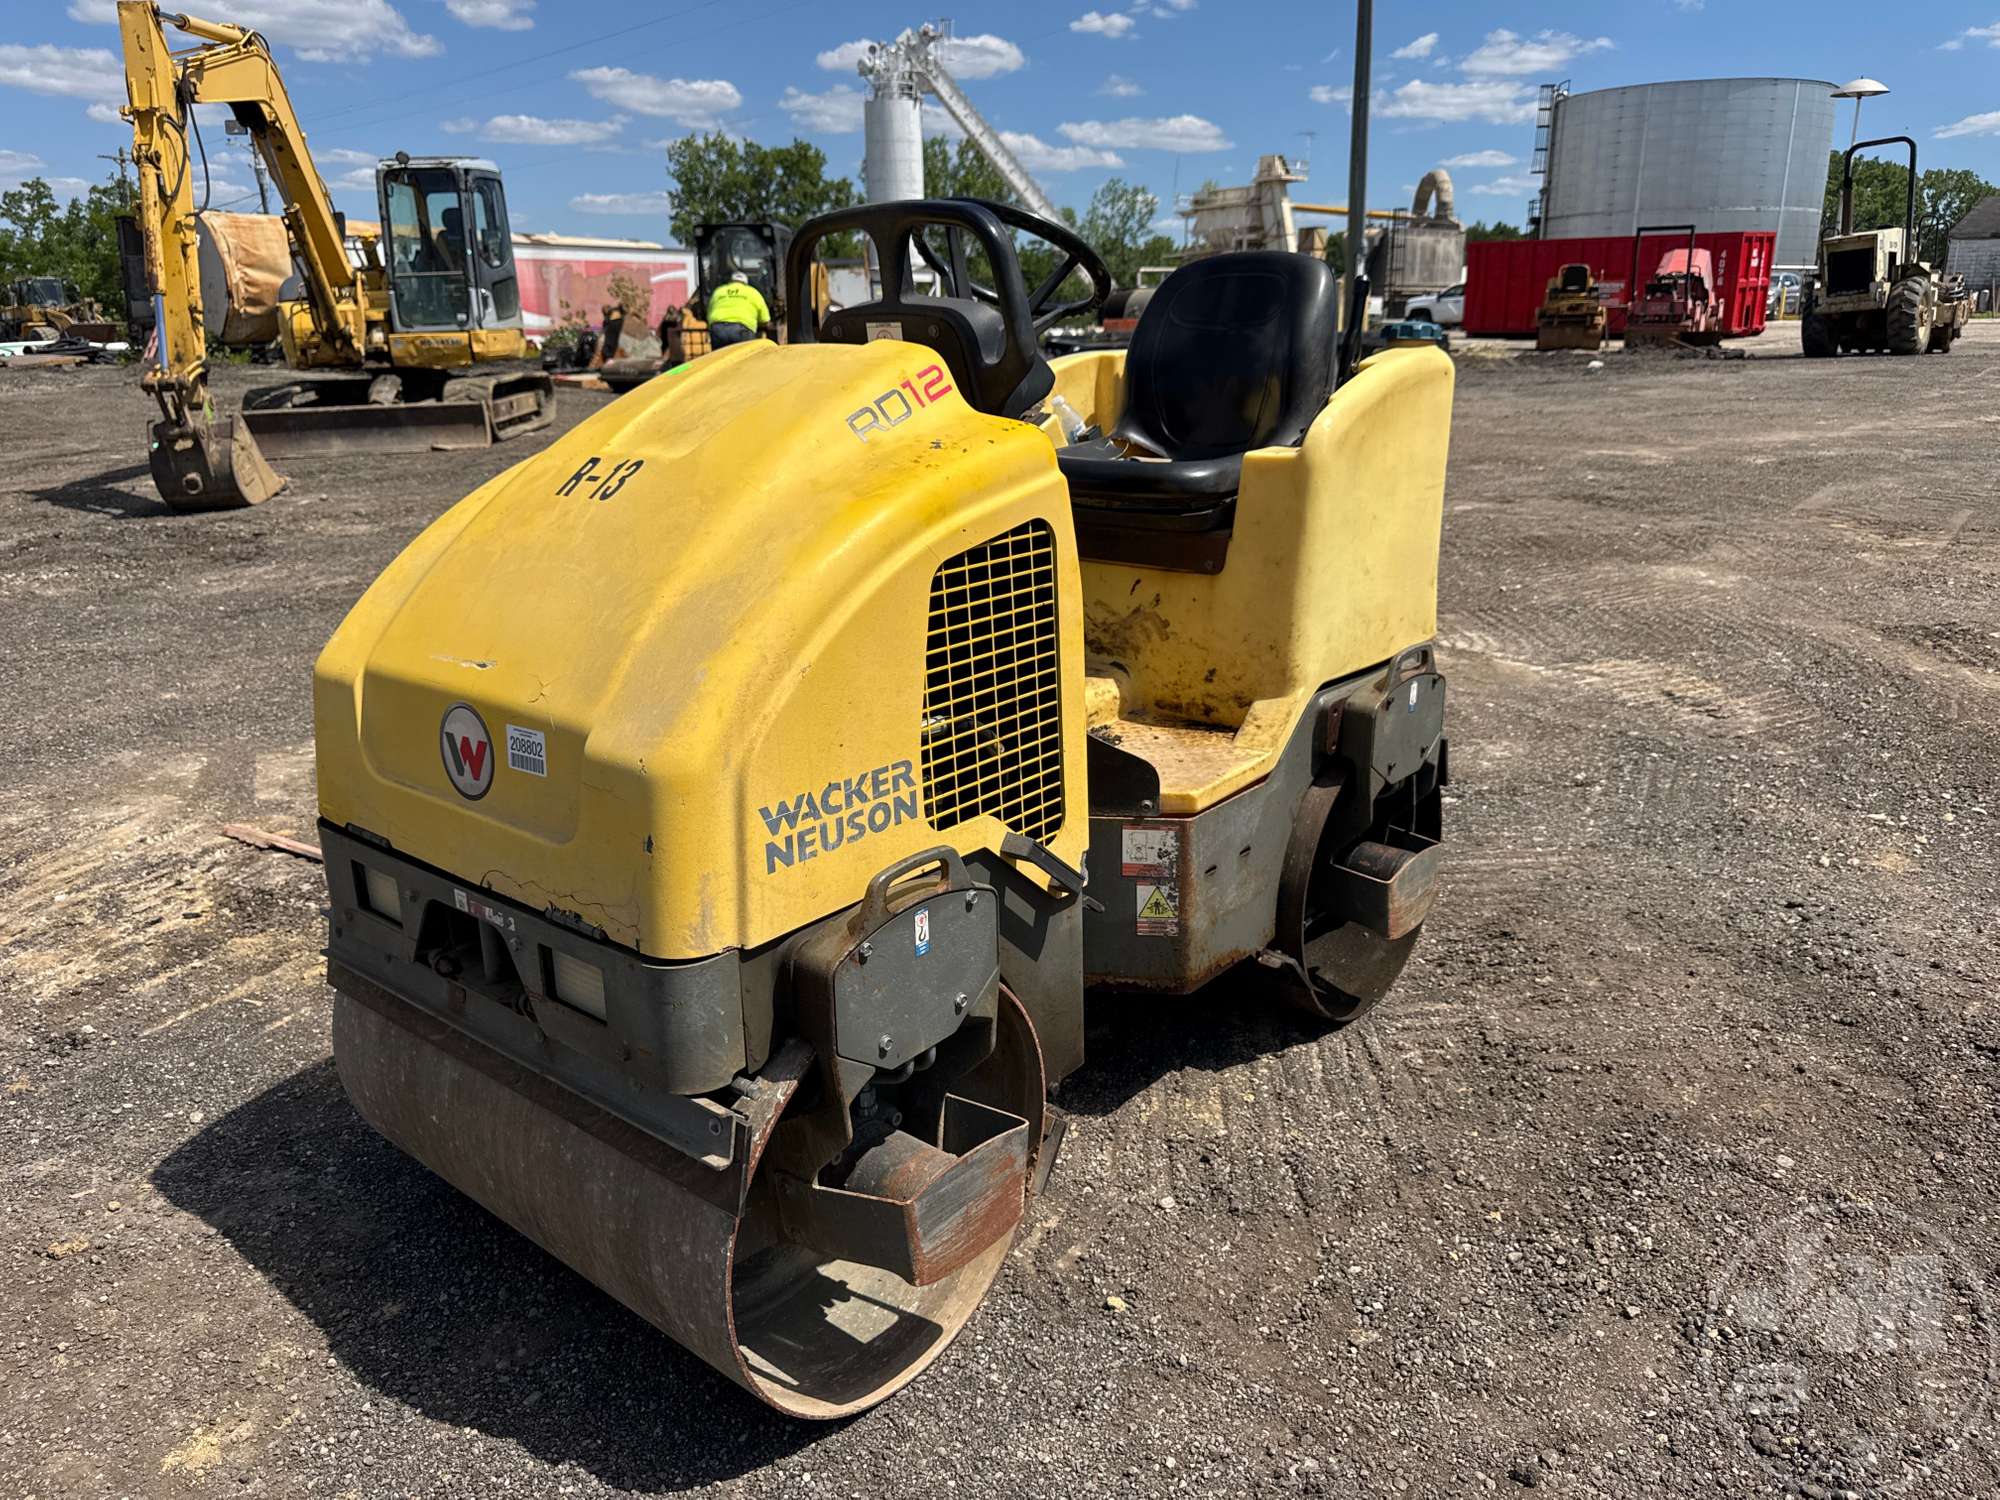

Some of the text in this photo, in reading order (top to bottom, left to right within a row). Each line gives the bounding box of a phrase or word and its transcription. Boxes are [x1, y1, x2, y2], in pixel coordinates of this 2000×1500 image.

[846, 364, 953, 444] RD12
[555, 457, 644, 501] R-13
[445, 731, 488, 781] W
[510, 735, 544, 758] 208802
[758, 759, 917, 836] WACKER
[765, 790, 918, 875] NEUSON
